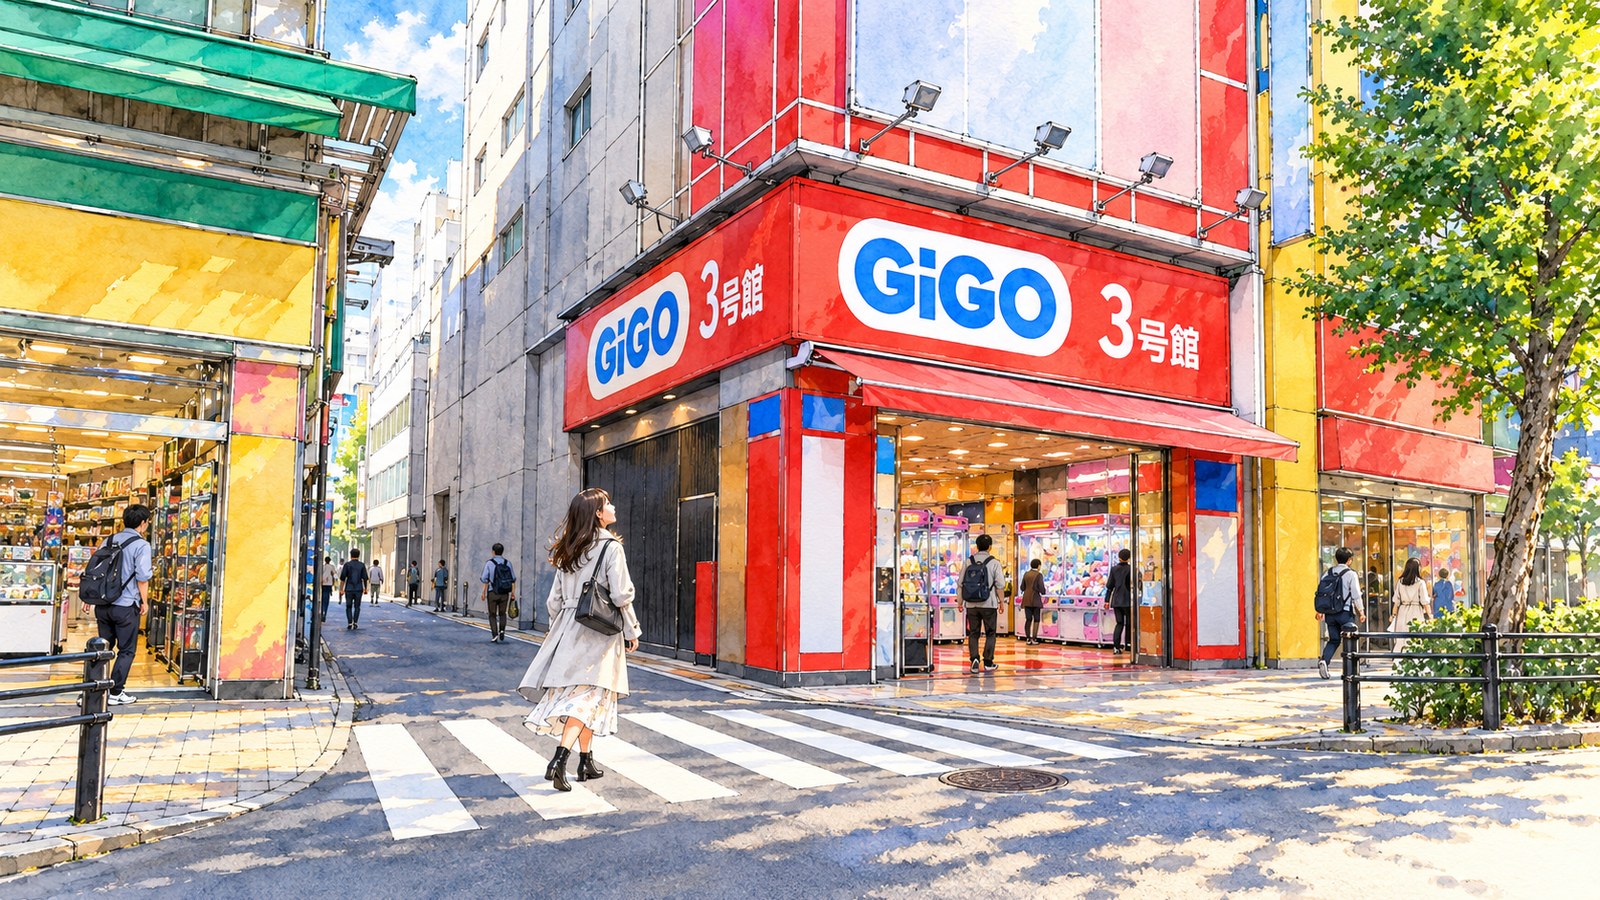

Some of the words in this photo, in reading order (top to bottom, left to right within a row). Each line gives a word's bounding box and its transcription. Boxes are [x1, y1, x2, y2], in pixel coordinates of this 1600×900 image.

[594, 290, 680, 385] GiGO
[698, 259, 765, 339] 3号館
[853, 237, 1058, 340] GiGO
[1097, 282, 1201, 371] 3号館
